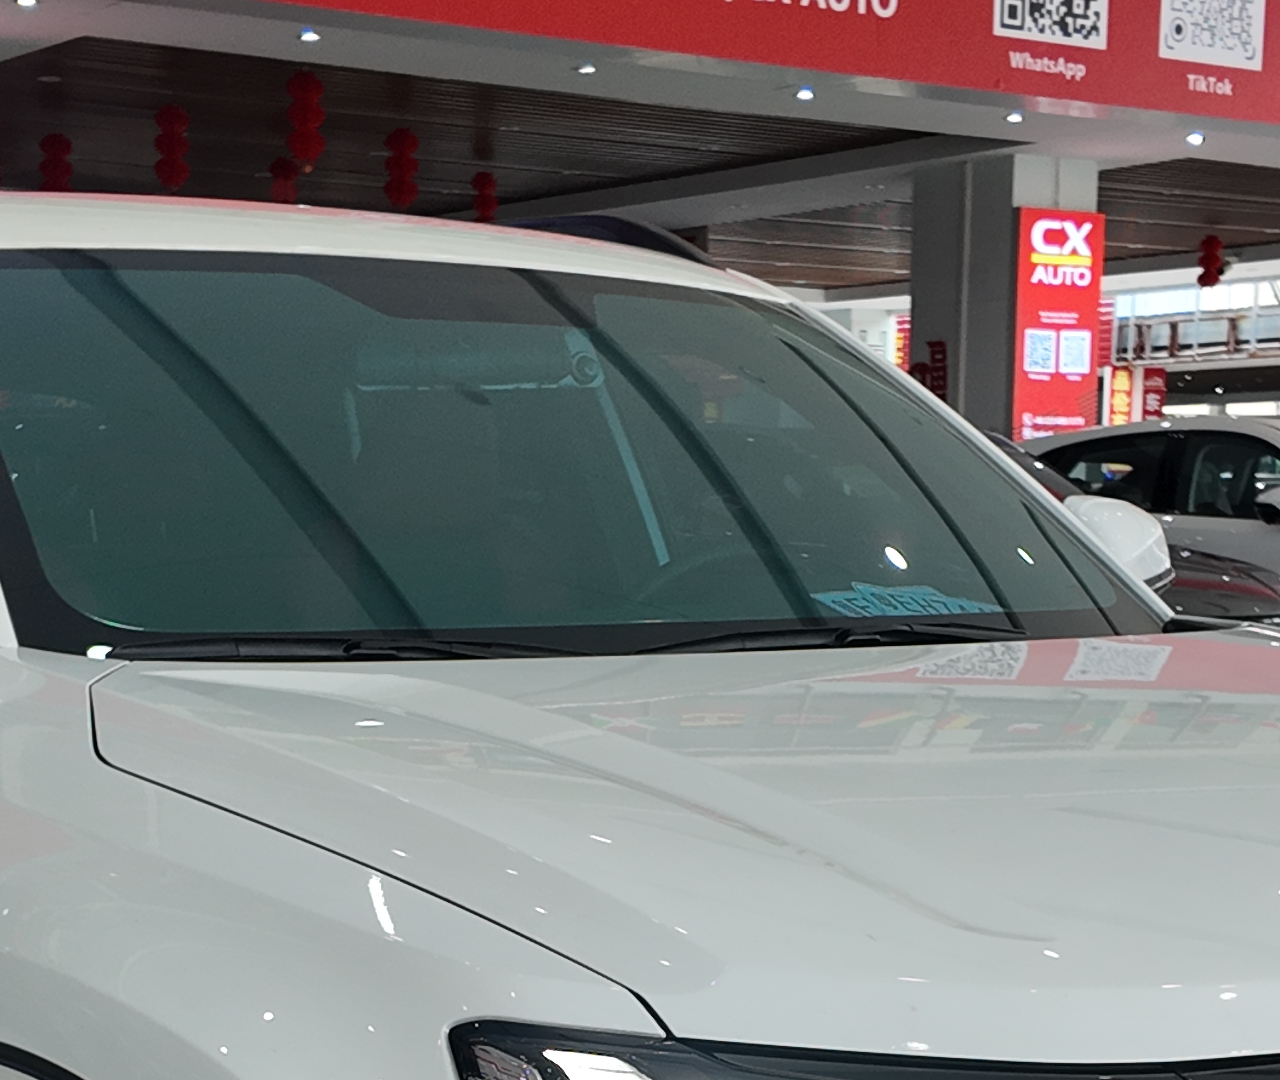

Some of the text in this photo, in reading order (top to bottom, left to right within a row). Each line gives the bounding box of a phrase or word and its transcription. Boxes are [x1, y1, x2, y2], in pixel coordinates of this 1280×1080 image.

[1009, 51, 1086, 82] WhatsApp
[1187, 74, 1233, 96] TikTok
[1030, 219, 1093, 257] CX
[1030, 265, 1092, 287] AUTO
